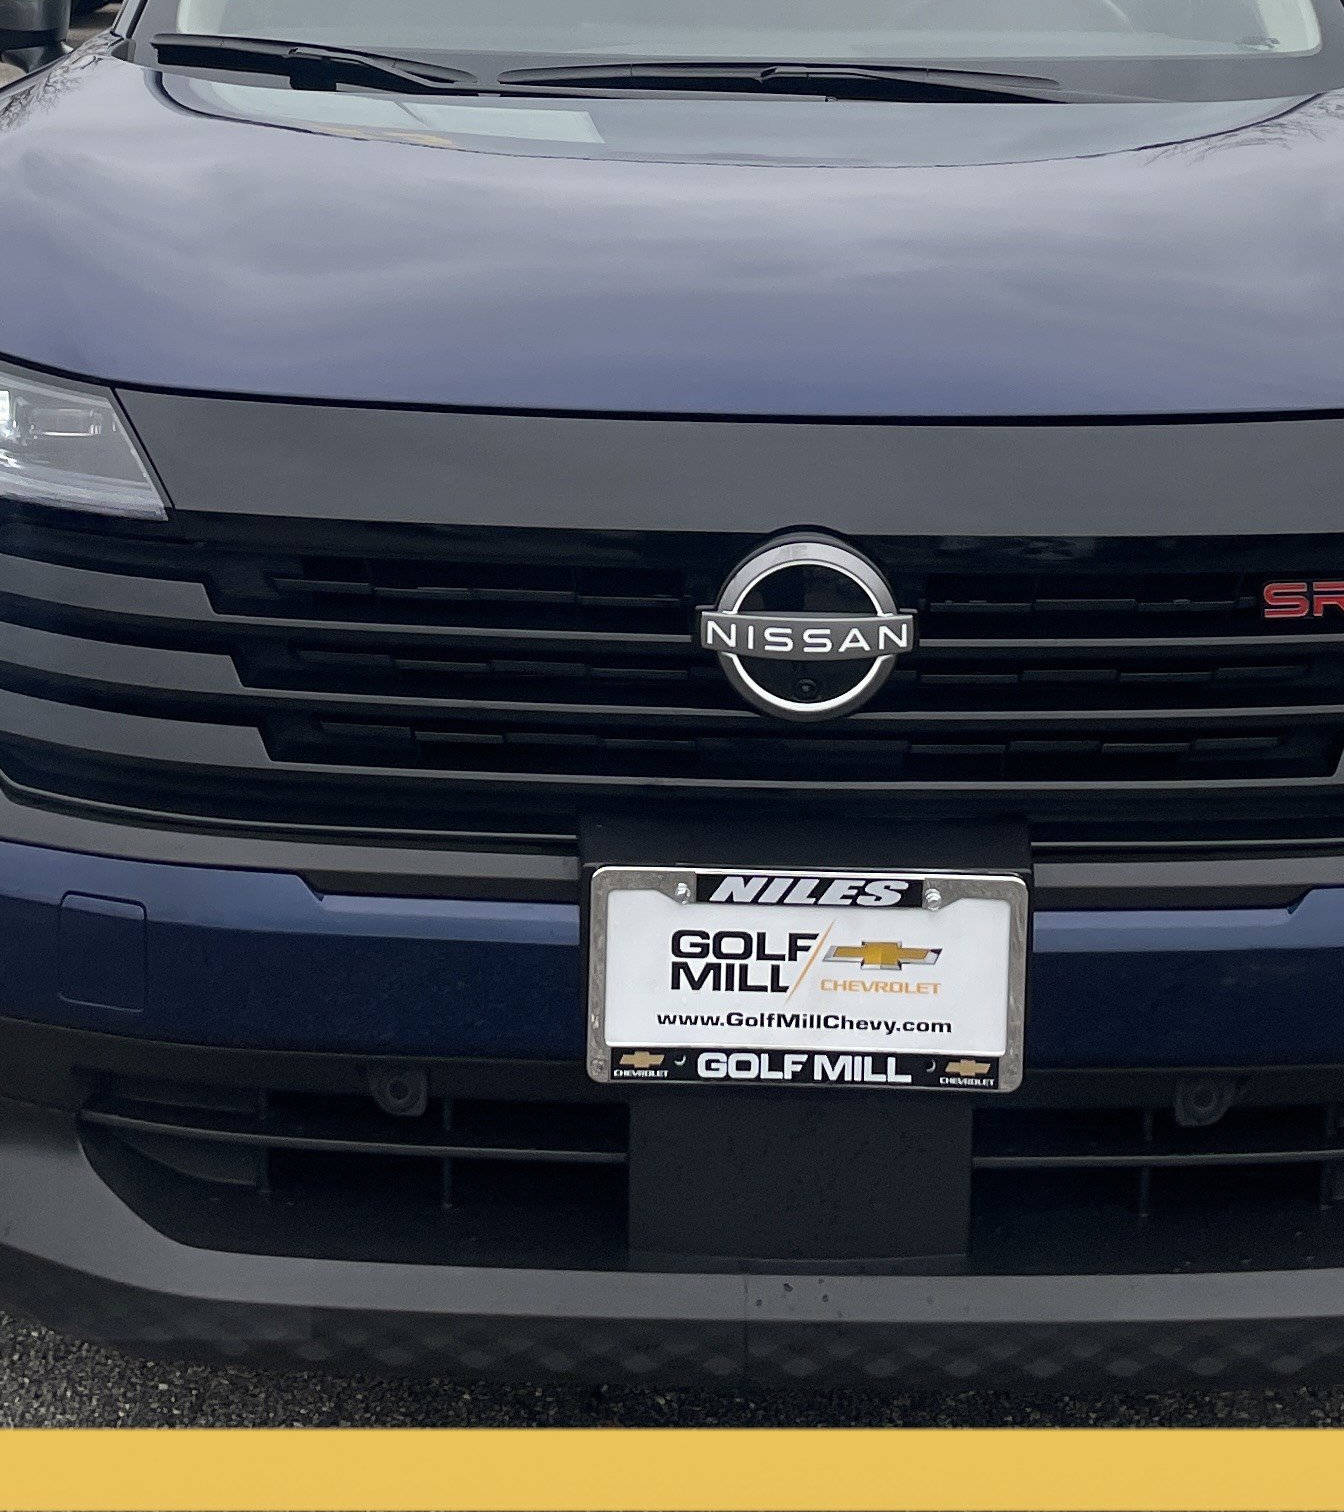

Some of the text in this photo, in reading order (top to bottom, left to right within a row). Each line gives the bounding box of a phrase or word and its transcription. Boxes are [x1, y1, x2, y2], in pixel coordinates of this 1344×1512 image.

[706, 620, 908, 653] NISSAN
[709, 876, 910, 908] NILES
[670, 928, 821, 962] GOLF
[670, 961, 791, 994] MILL
[819, 978, 942, 996] CHEVROLET
[655, 1011, 954, 1036] www.GolfMillChevy.com
[613, 1068, 669, 1078] CHEVROLET
[696, 1051, 913, 1084] GOLF MILL
[939, 1075, 996, 1087] CHEVROLET
